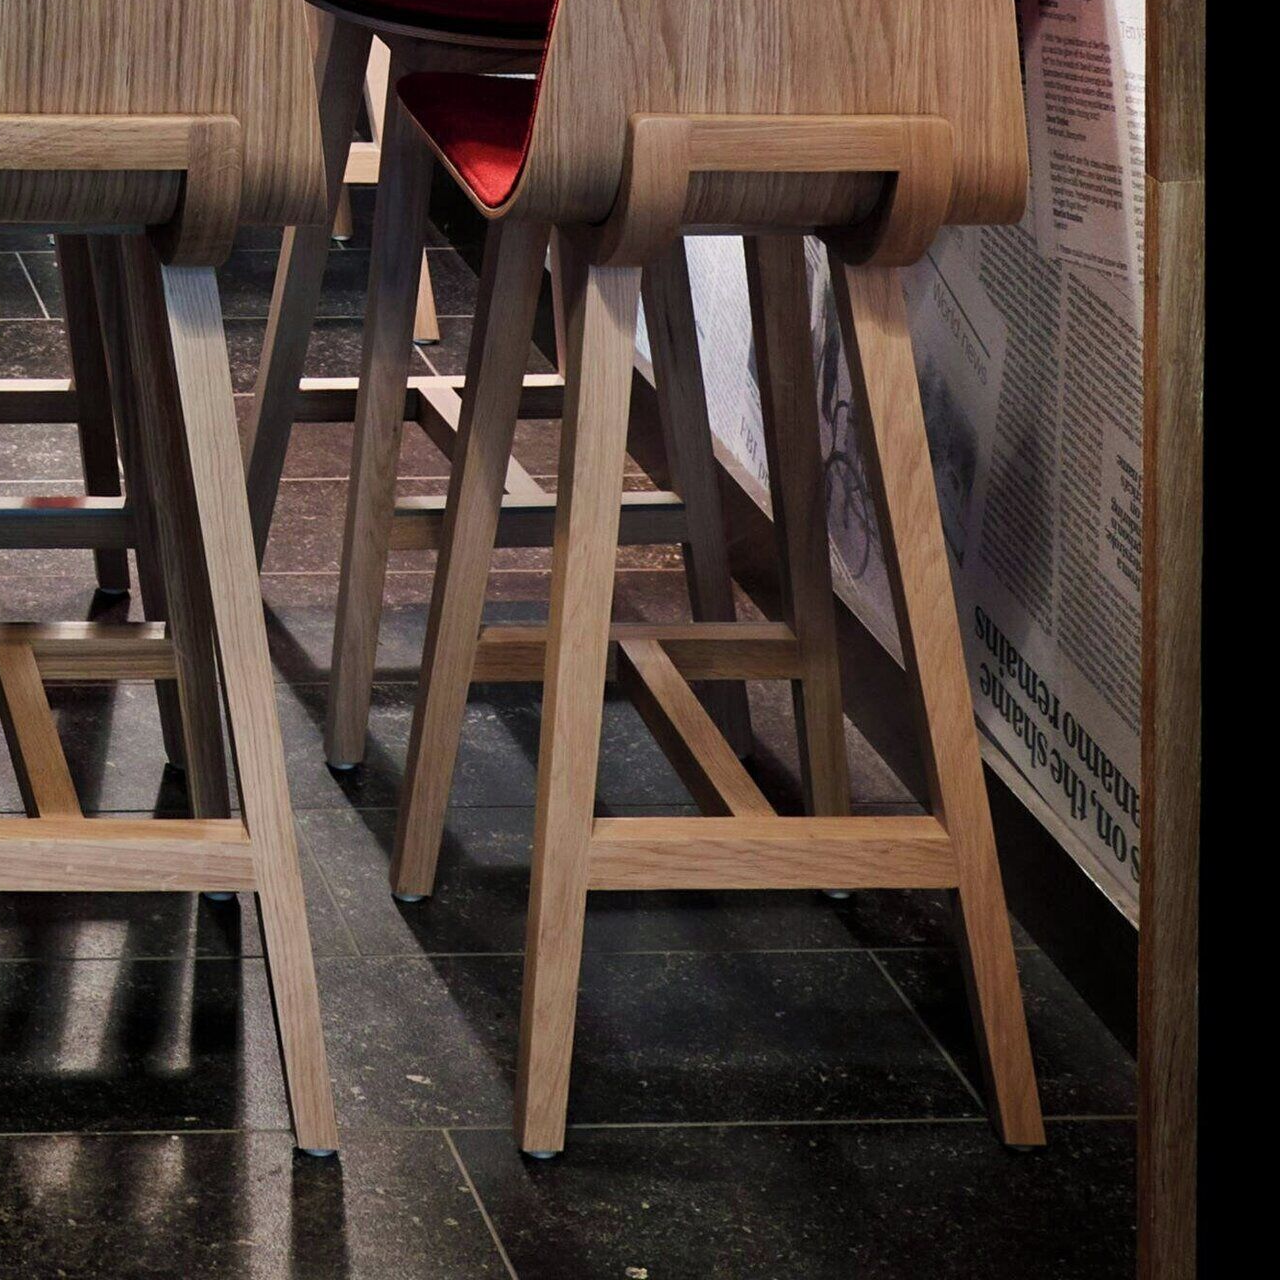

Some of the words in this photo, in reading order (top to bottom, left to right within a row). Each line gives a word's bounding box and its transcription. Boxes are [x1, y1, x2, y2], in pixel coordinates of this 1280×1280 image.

[933, 280, 961, 338] World
[960, 332, 988, 386] news
[974, 604, 1060, 731] remains
[979, 661, 1049, 769] shame
[1050, 748, 1089, 821] the
[1091, 789, 1128, 864] on,
